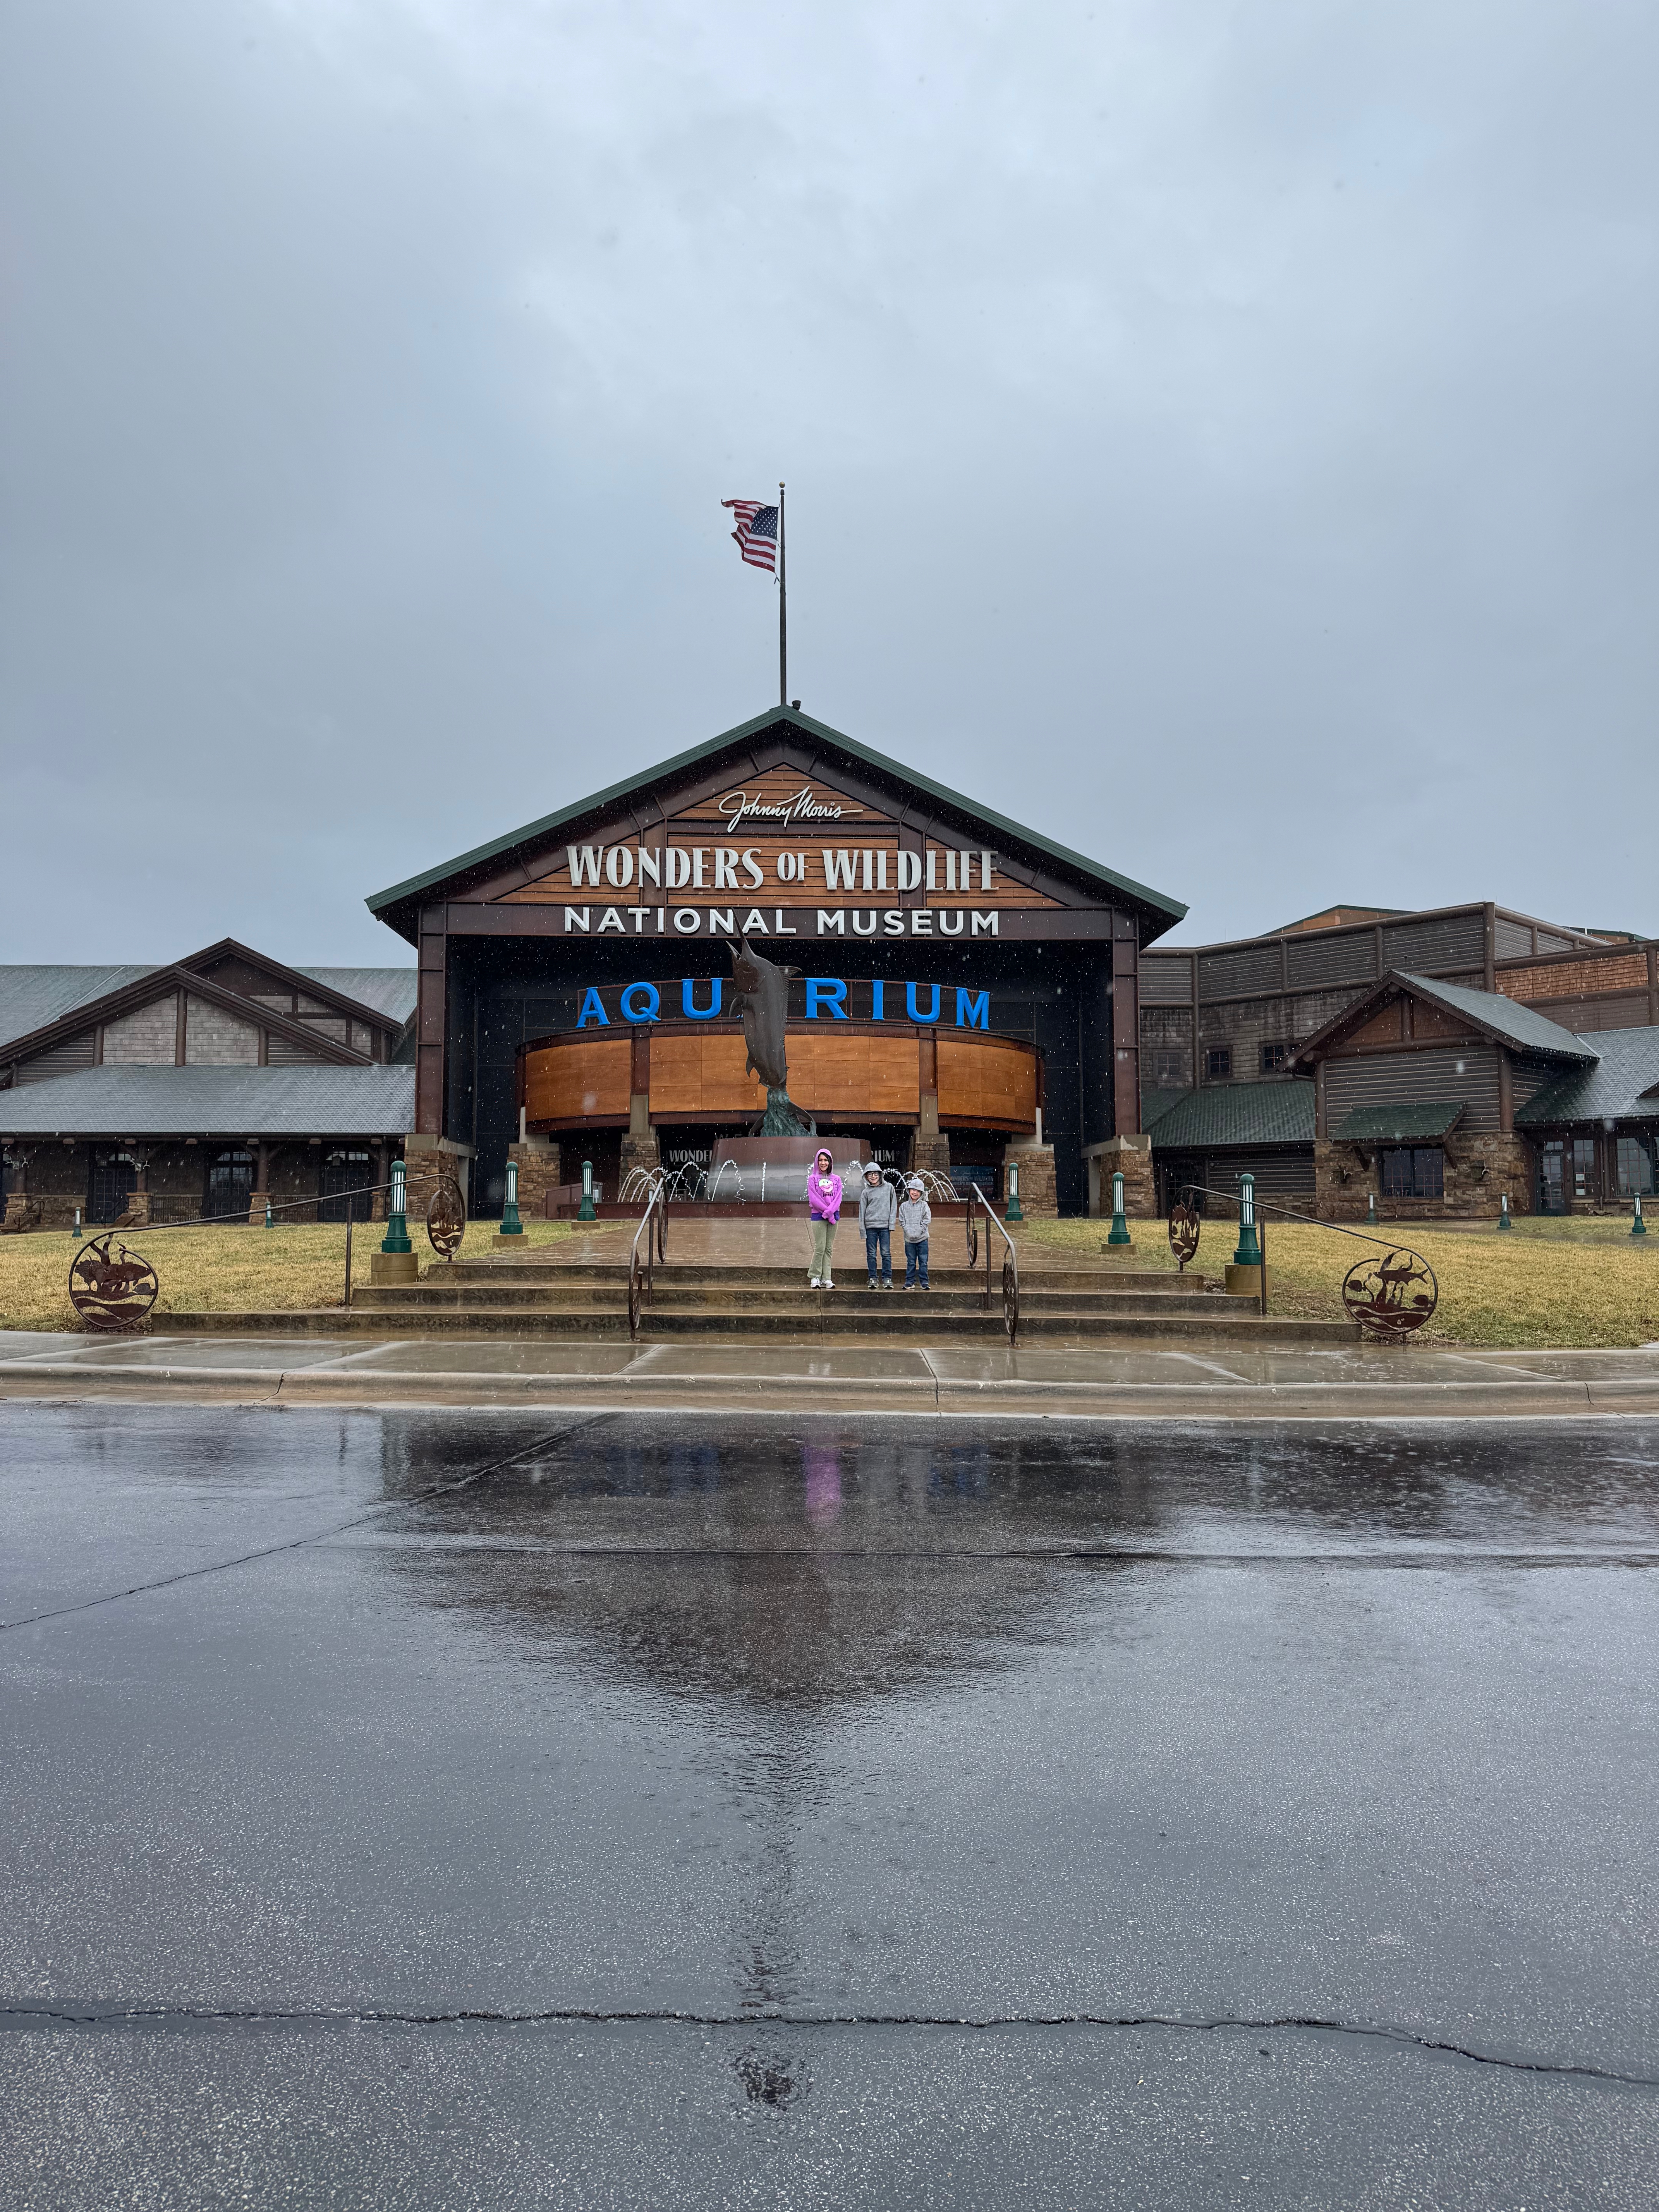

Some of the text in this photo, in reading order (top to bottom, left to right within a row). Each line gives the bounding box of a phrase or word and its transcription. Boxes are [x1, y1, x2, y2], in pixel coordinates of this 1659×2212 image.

[719, 785, 864, 833] Johnny Morris
[566, 846, 999, 891] WONDERS OF WILDLIFE
[565, 907, 999, 936] NATIONAL MUSEUM
[575, 977, 991, 1030] AQURIUM
